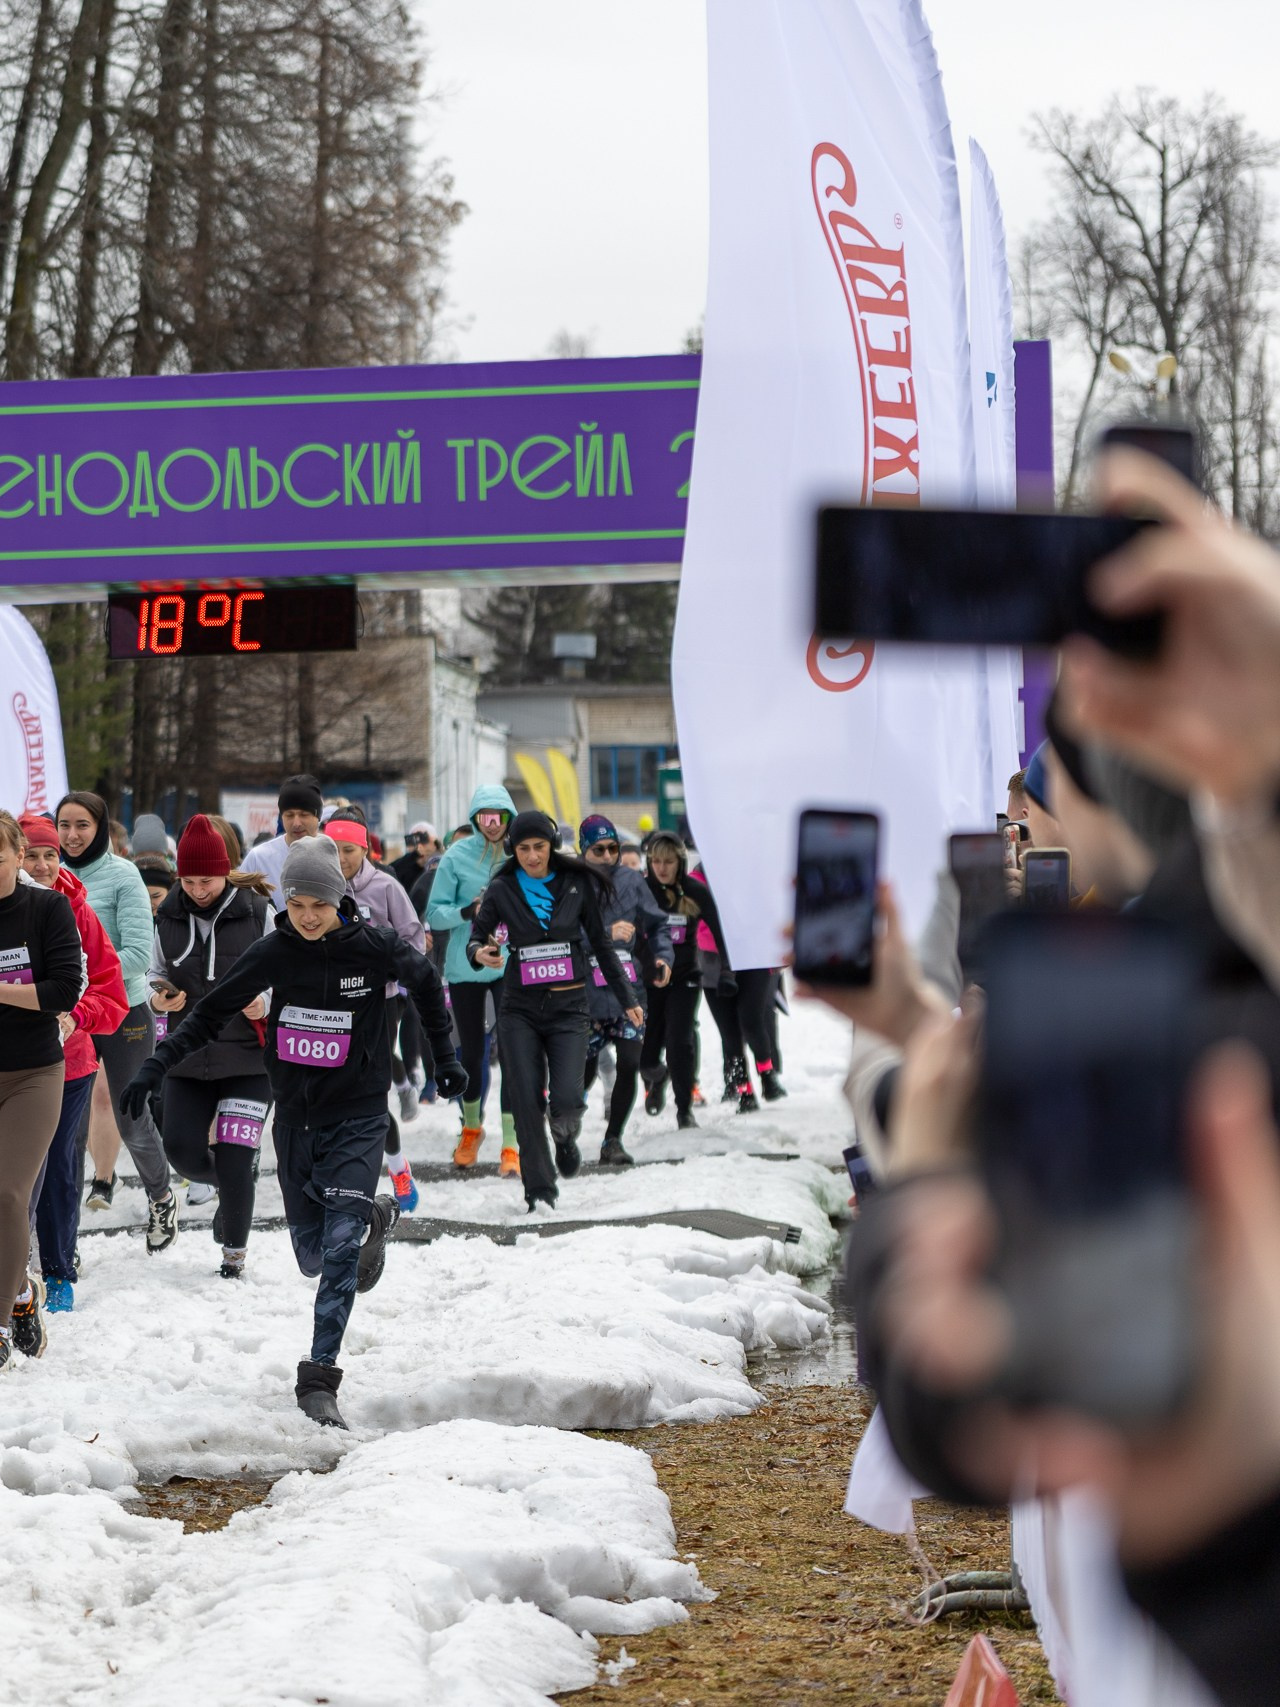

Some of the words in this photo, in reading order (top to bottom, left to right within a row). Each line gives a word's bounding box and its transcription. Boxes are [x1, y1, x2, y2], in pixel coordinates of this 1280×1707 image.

[137, 594, 186, 655] 18
[528, 963, 567, 979] 1085
[340, 976, 365, 989] HIGH
[286, 1037, 340, 1060] 1080
[222, 1122, 259, 1142] 1135
